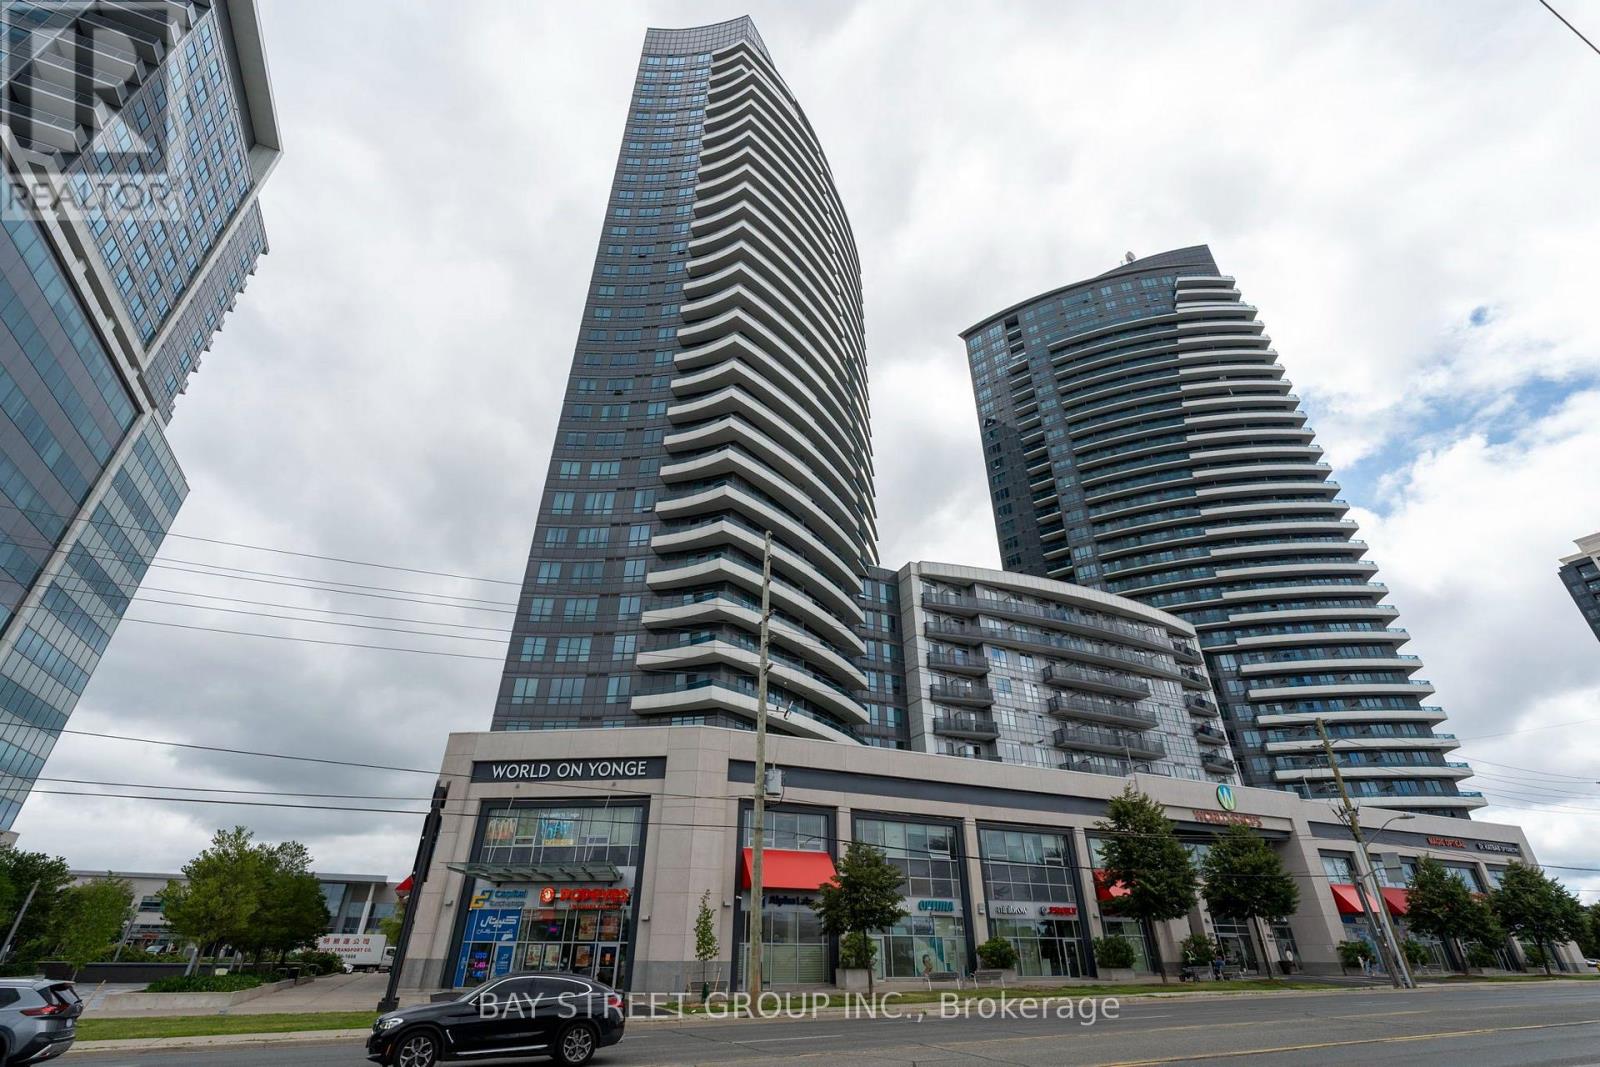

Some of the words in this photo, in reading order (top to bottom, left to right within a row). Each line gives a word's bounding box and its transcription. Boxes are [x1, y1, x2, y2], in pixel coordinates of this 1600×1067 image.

[492, 763, 550, 779] WORLD
[556, 762, 583, 777] ON
[588, 760, 647, 777] YONGE
